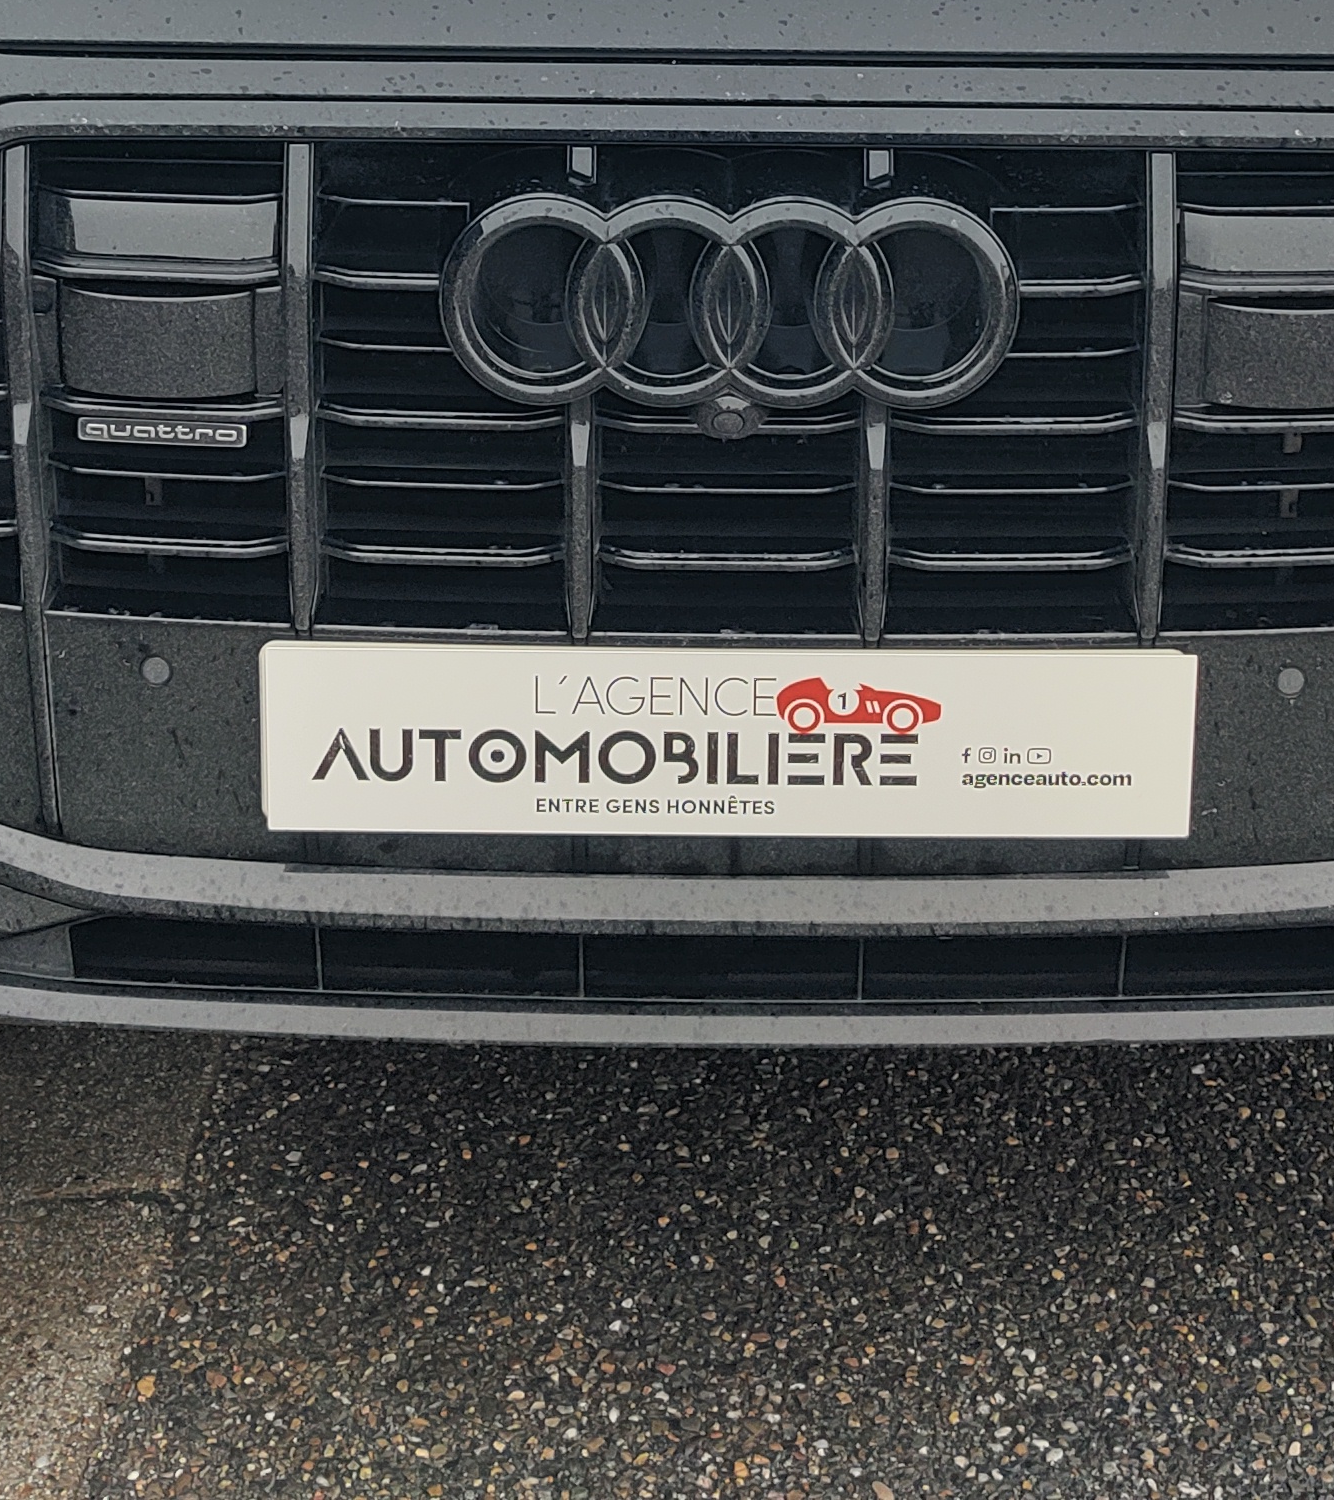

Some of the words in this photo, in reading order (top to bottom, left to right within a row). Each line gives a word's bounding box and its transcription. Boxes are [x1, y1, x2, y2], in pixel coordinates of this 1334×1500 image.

[85, 423, 238, 442] quattro
[535, 675, 778, 717] L'AGENCE
[961, 771, 1132, 789] agenceauto.com
[535, 798, 600, 814] ENTRE
[605, 799, 661, 814] GENS
[666, 795, 776, 815] HONNÊTES
